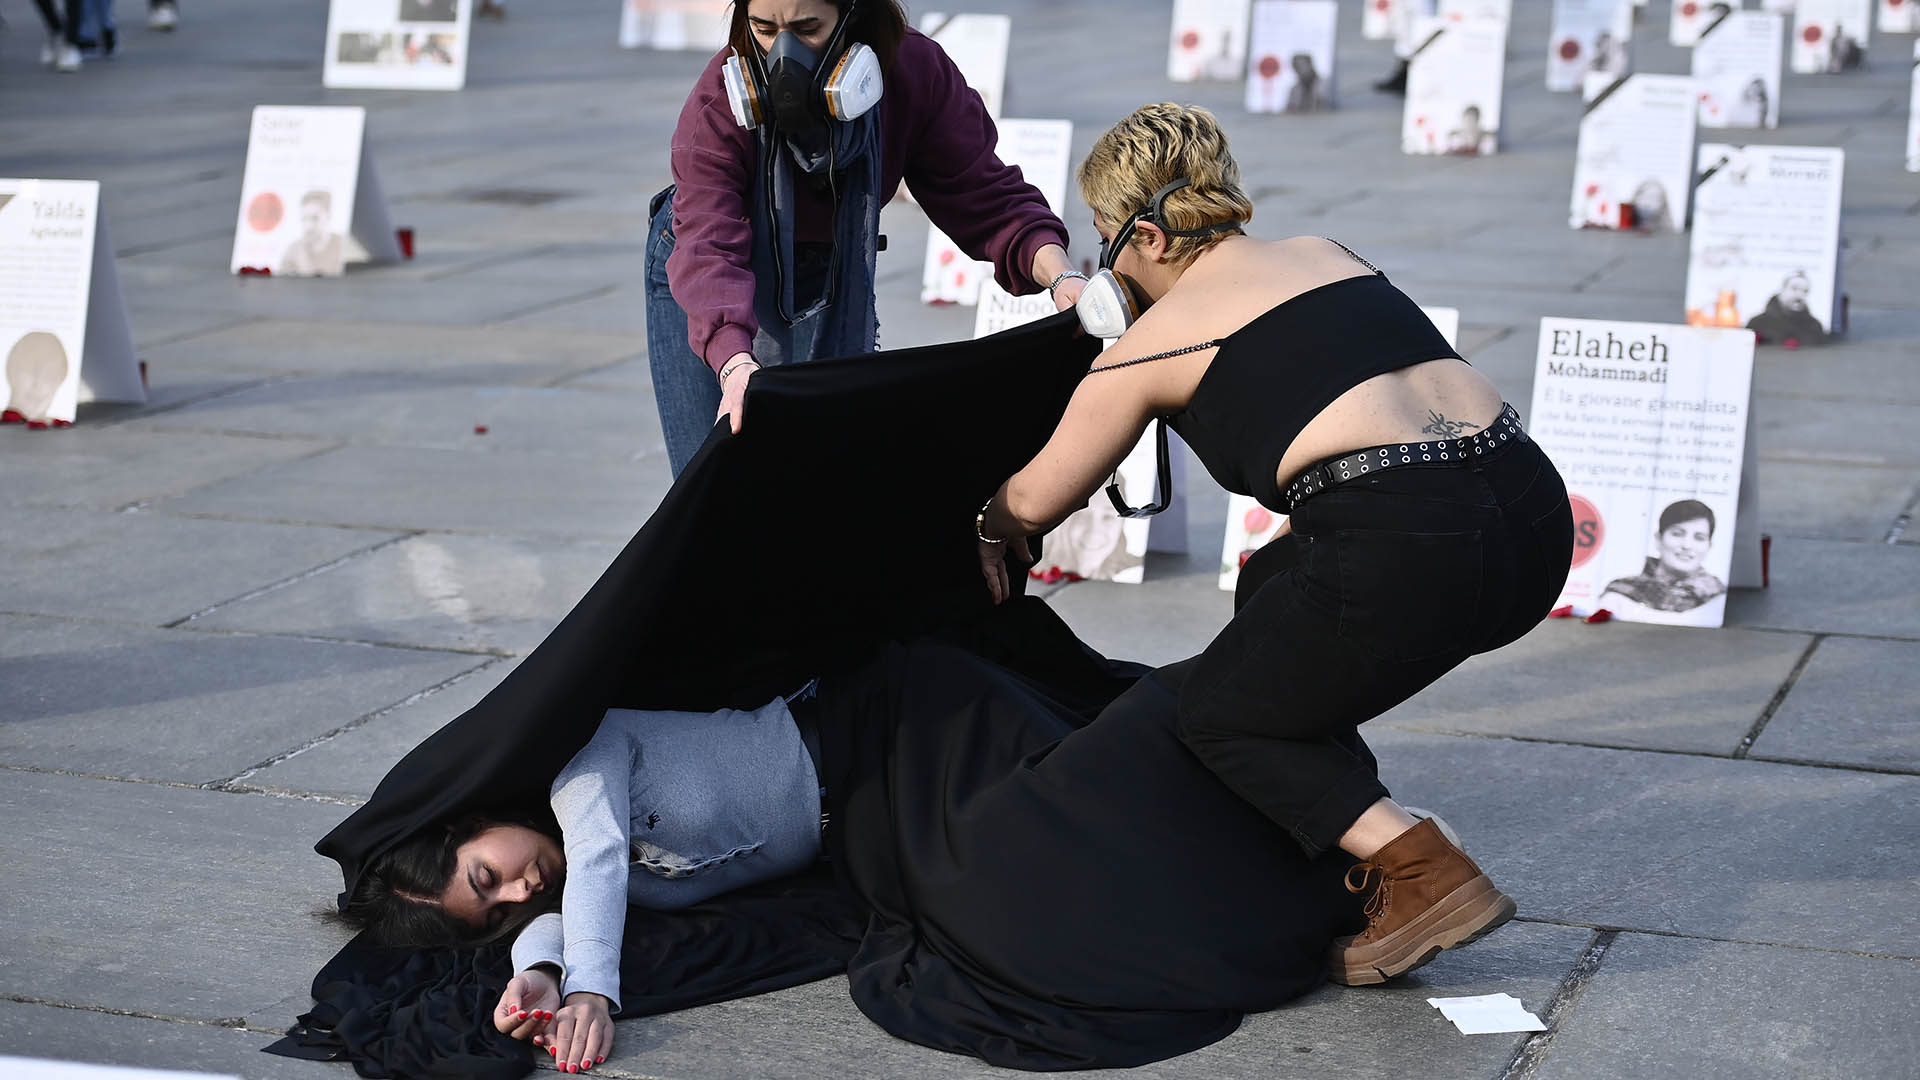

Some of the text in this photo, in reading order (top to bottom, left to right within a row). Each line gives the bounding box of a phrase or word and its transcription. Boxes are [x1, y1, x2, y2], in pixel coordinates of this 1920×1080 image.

[32, 200, 86, 219] Yalda
[989, 293, 1055, 316] Niloo
[1551, 329, 1669, 363] Elaheh
[1547, 361, 1668, 384] Mohammadi
[1559, 388, 1573, 405] la
[1578, 391, 1642, 409] giovane
[1648, 397, 1738, 417] giornalista
[1686, 469, 1720, 483] dove
